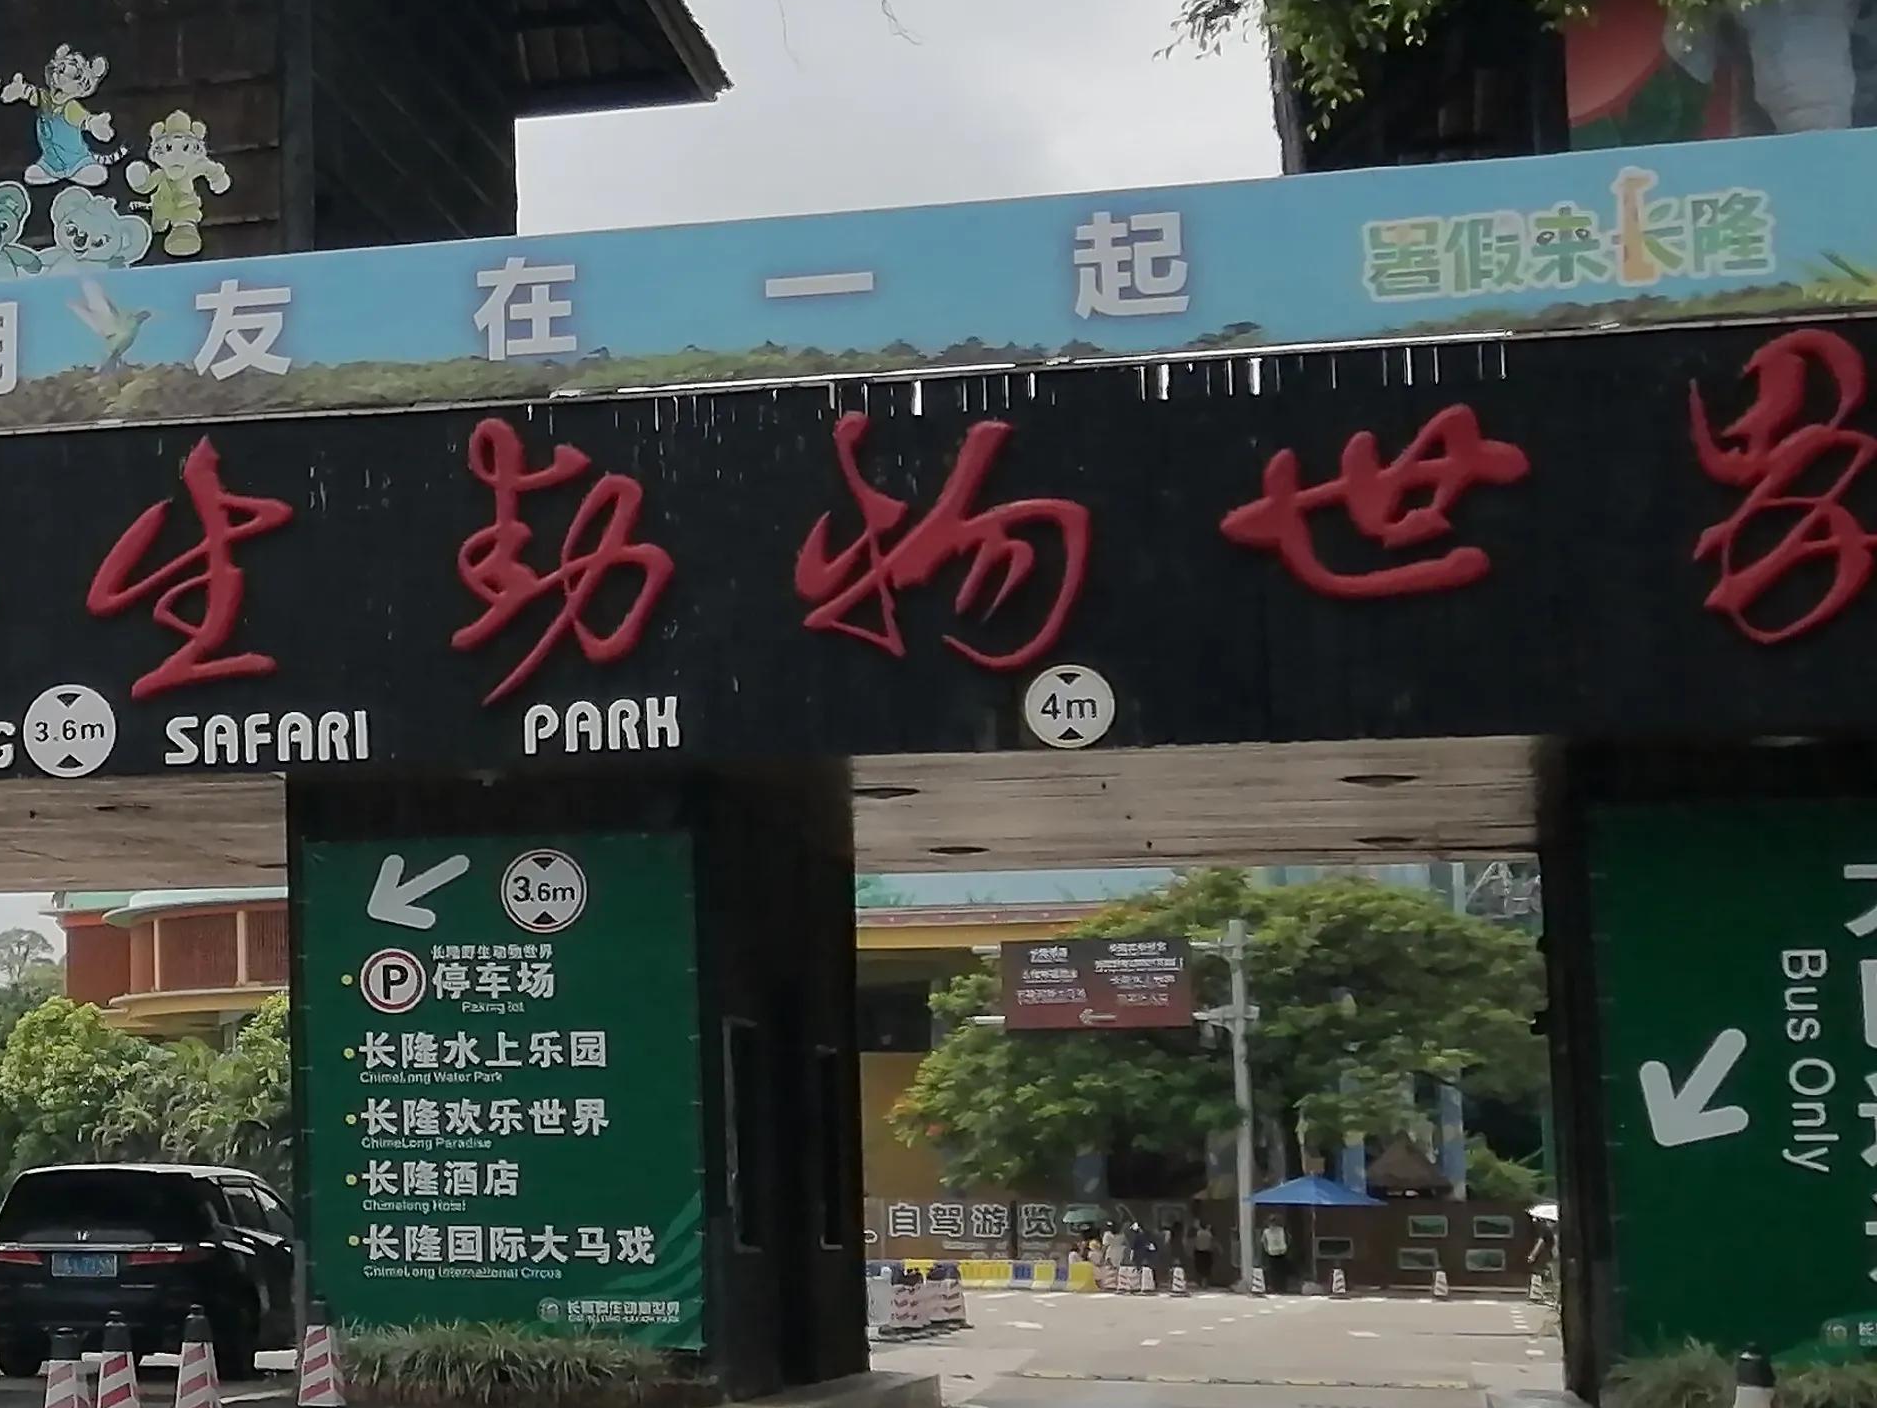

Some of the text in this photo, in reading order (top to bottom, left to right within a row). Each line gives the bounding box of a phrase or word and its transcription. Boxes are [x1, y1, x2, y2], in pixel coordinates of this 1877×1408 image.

[1365, 170, 1772, 298] 暑假来长隆
[1041, 693, 1098, 720] 4m
[33, 718, 106, 744] 3.6m
[164, 711, 370, 766] SAFARI
[523, 696, 681, 755] PARK
[512, 875, 576, 904] 3.6m
[432, 962, 554, 999] 停车场
[359, 1031, 607, 1069] 长隆水上乐园
[1782, 949, 1840, 1173] Bus Only
[474, 1071, 502, 1083] Park
[361, 1098, 609, 1136] 长隆欢乐世界
[362, 1159, 519, 1196] 长隆酒店
[363, 1224, 656, 1264] 长隆国际大马戏
